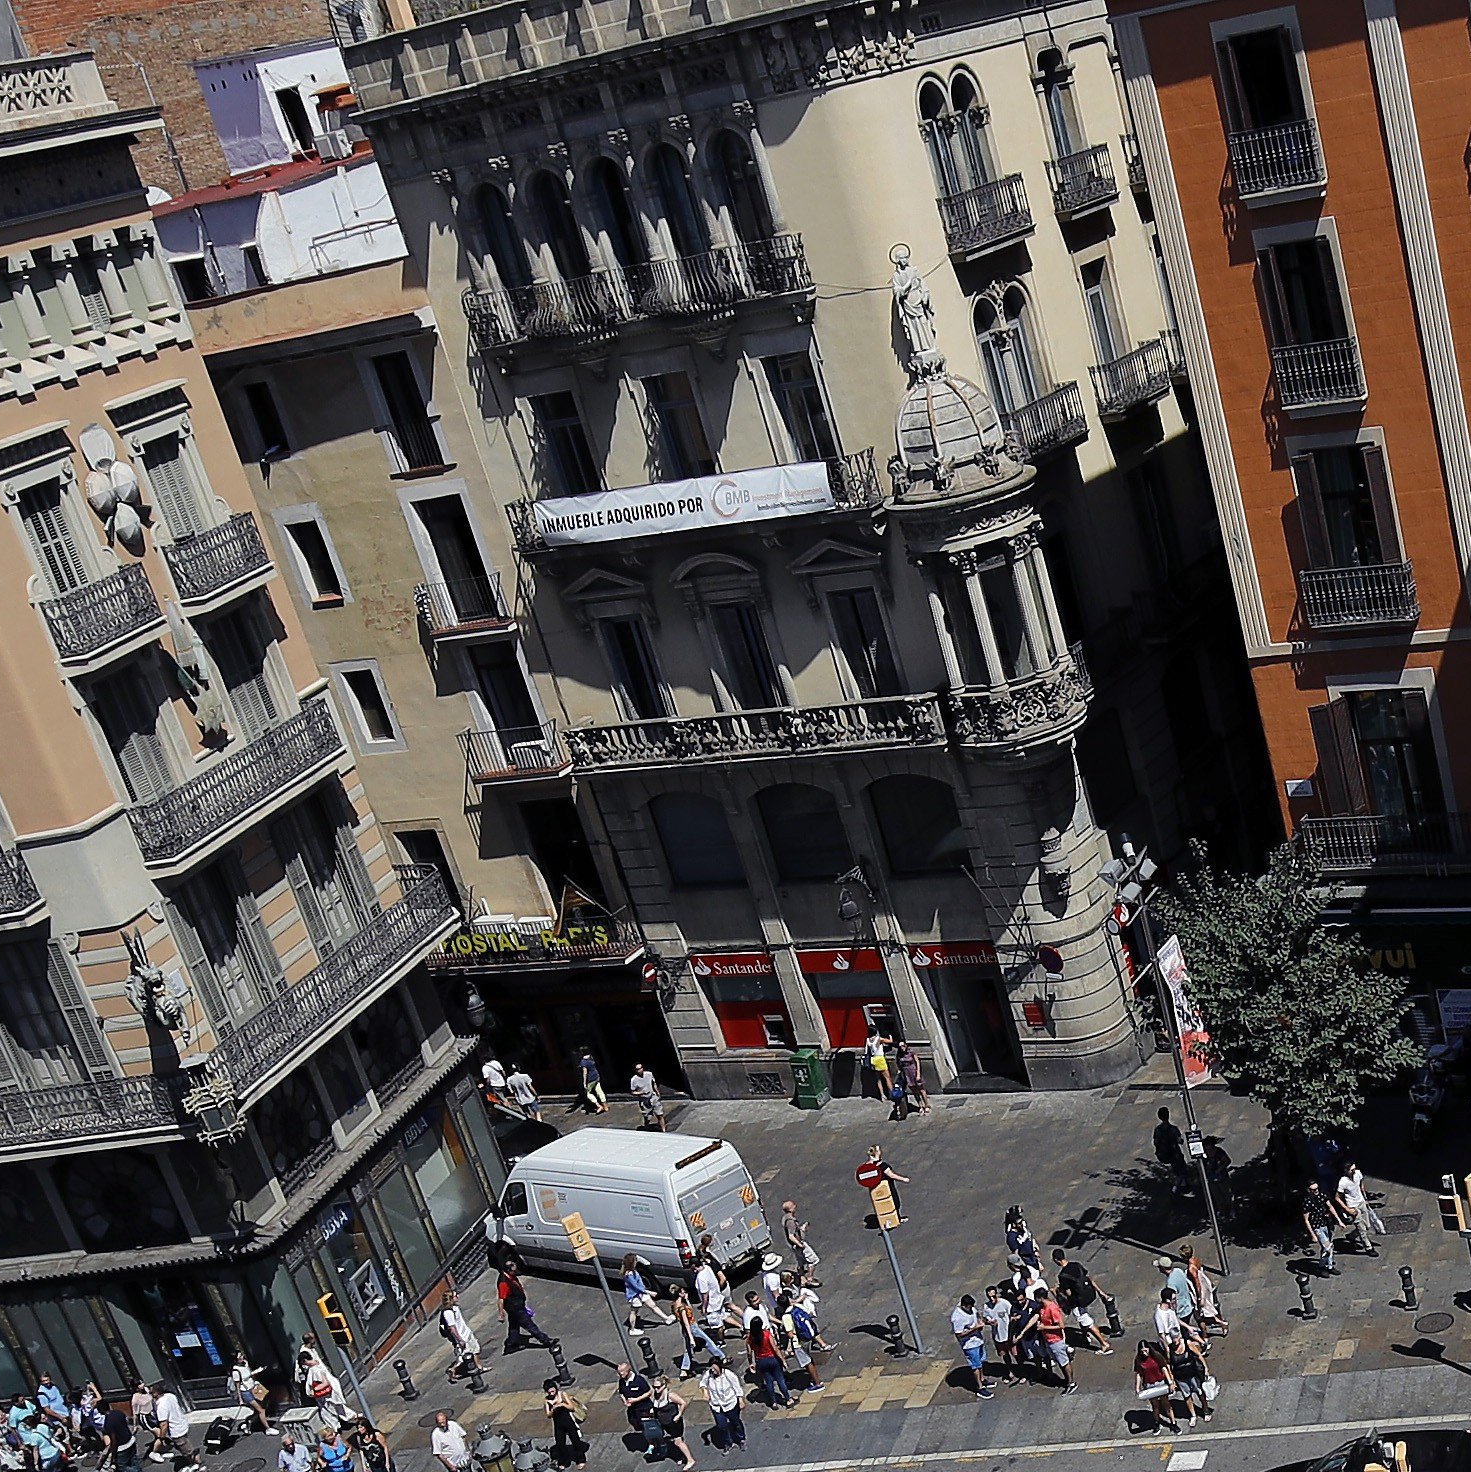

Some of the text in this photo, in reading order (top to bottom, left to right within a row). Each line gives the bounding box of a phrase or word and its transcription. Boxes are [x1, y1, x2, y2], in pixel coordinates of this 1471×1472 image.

[725, 490, 751, 505] BMB
[542, 497, 704, 534] INMUEBLE ADQUIRIDO POR
[933, 950, 998, 965] Santander
[714, 961, 773, 975] Santander
